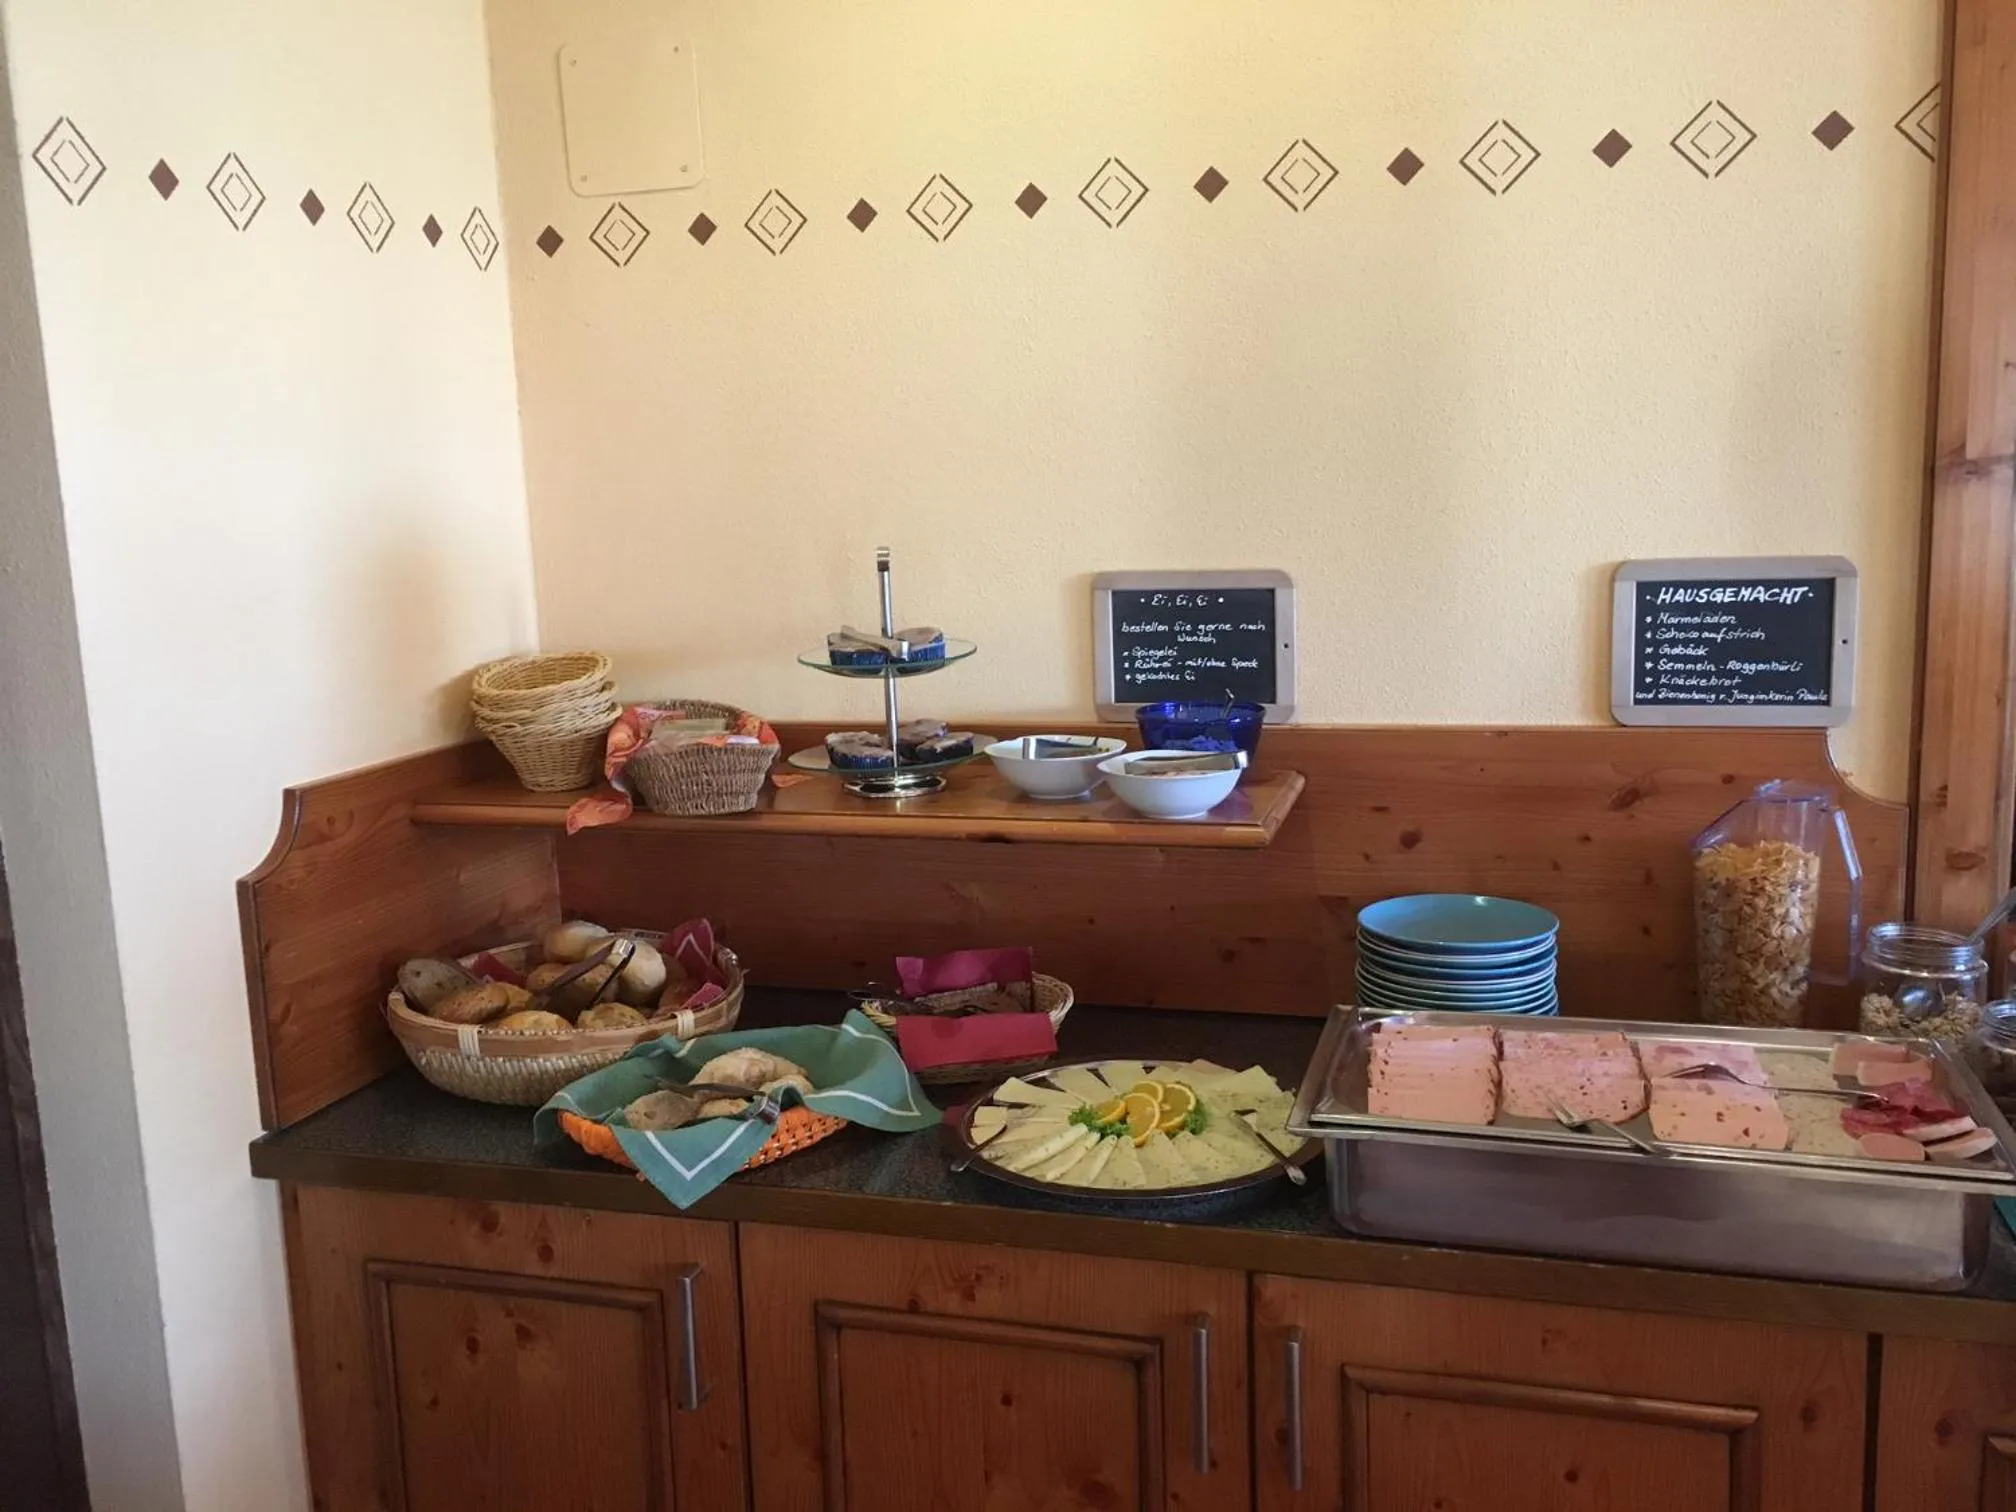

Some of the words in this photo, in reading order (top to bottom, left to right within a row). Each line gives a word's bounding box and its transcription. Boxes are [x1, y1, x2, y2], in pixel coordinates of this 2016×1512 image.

[1657, 586, 1809, 605] HAUSGEMACHT
[1657, 611, 1737, 625] Marmeladen
[1121, 622, 1168, 632] bestellen
[1174, 621, 1191, 631] Sie
[1198, 624, 1233, 634] gerne
[1239, 620, 1265, 631] nach
[1177, 634, 1216, 643] Wunsch
[1658, 659, 1716, 671] Semmeln
[1660, 674, 1742, 686] Knäckebrot
